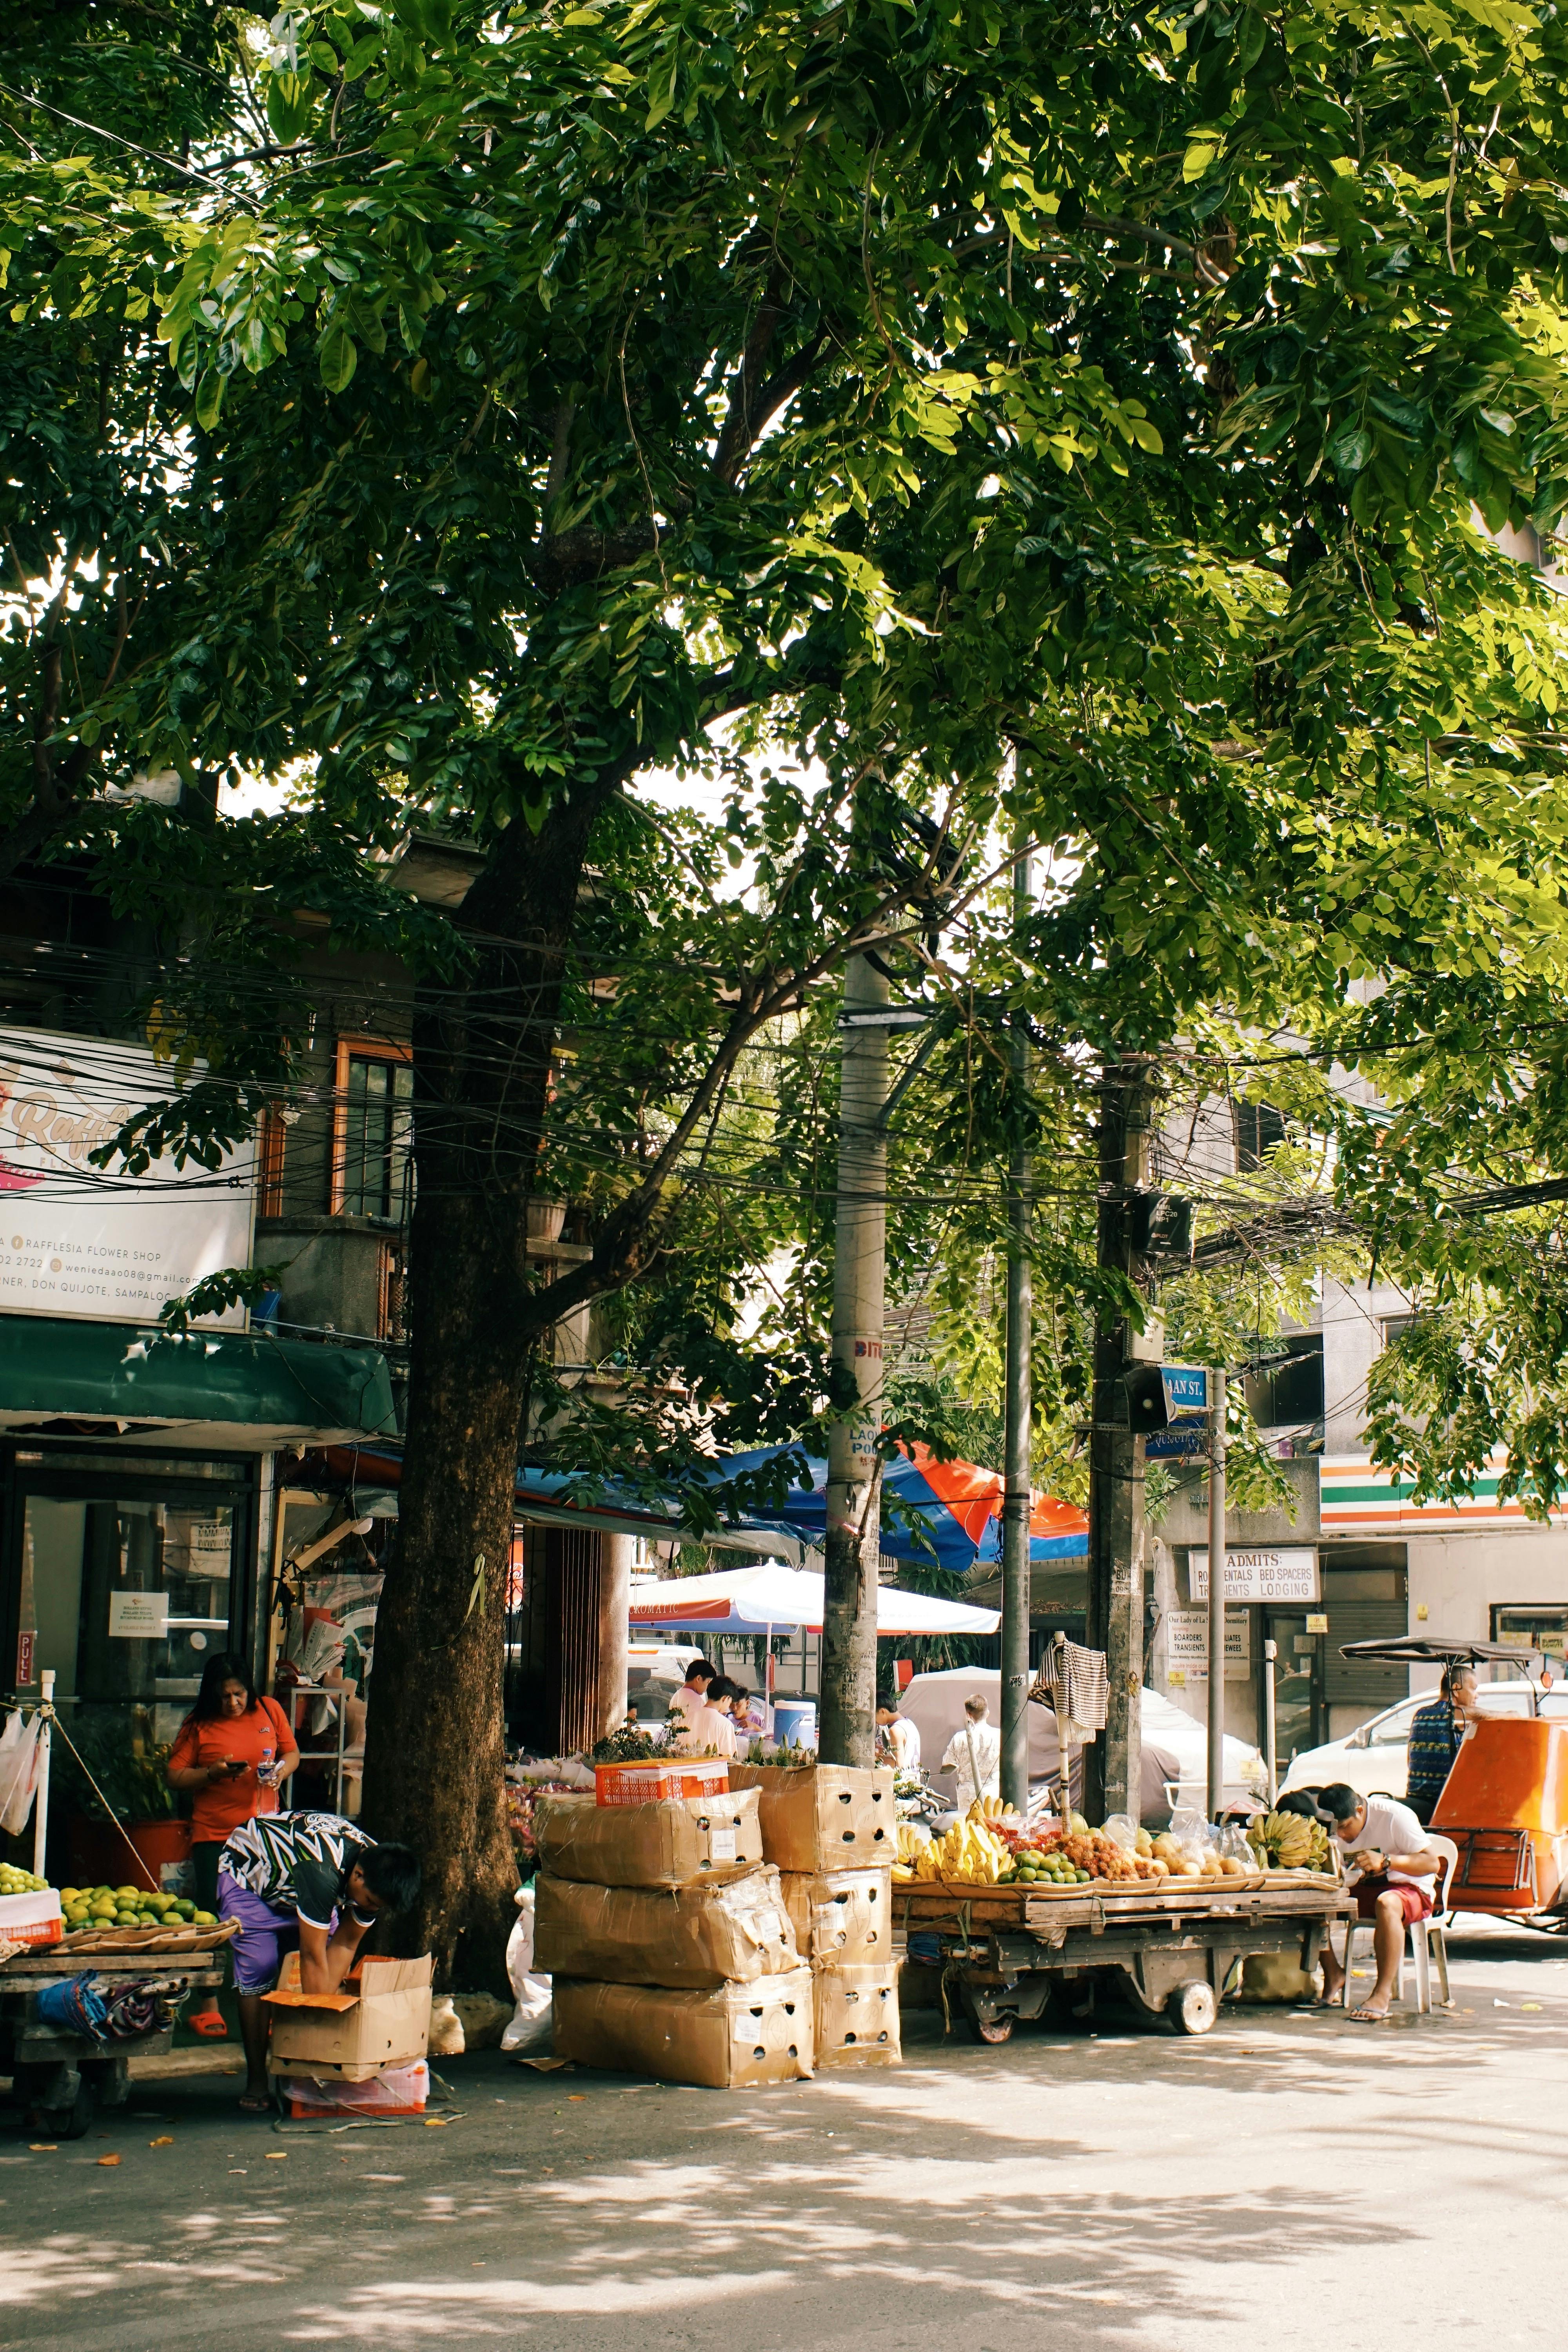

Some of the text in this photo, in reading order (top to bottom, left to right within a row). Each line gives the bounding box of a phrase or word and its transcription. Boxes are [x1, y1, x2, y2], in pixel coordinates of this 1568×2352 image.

[26, 1239, 82, 1254] RAFFLESIA
[87, 1246, 128, 1258] FLOWER
[133, 1251, 161, 1261] SHOP
[16, 1257, 43, 1268] 2722
[66, 1265, 200, 1283] weniedaao08@gmail.com
[0, 1277, 26, 1289] NER,
[32, 1279, 55, 1290] DON
[61, 1283, 110, 1297] QUIJOTE,
[1167, 1379, 1202, 1396] AAN ST.
[1226, 1554, 1282, 1567] ADMITS:
[1198, 1568, 1312, 1582] RO ENTALS BED SPACERS
[1261, 1583, 1308, 1596] LODGING
[1180, 1615, 1192, 1625] Lady
[21, 1637, 29, 1681] PULL
